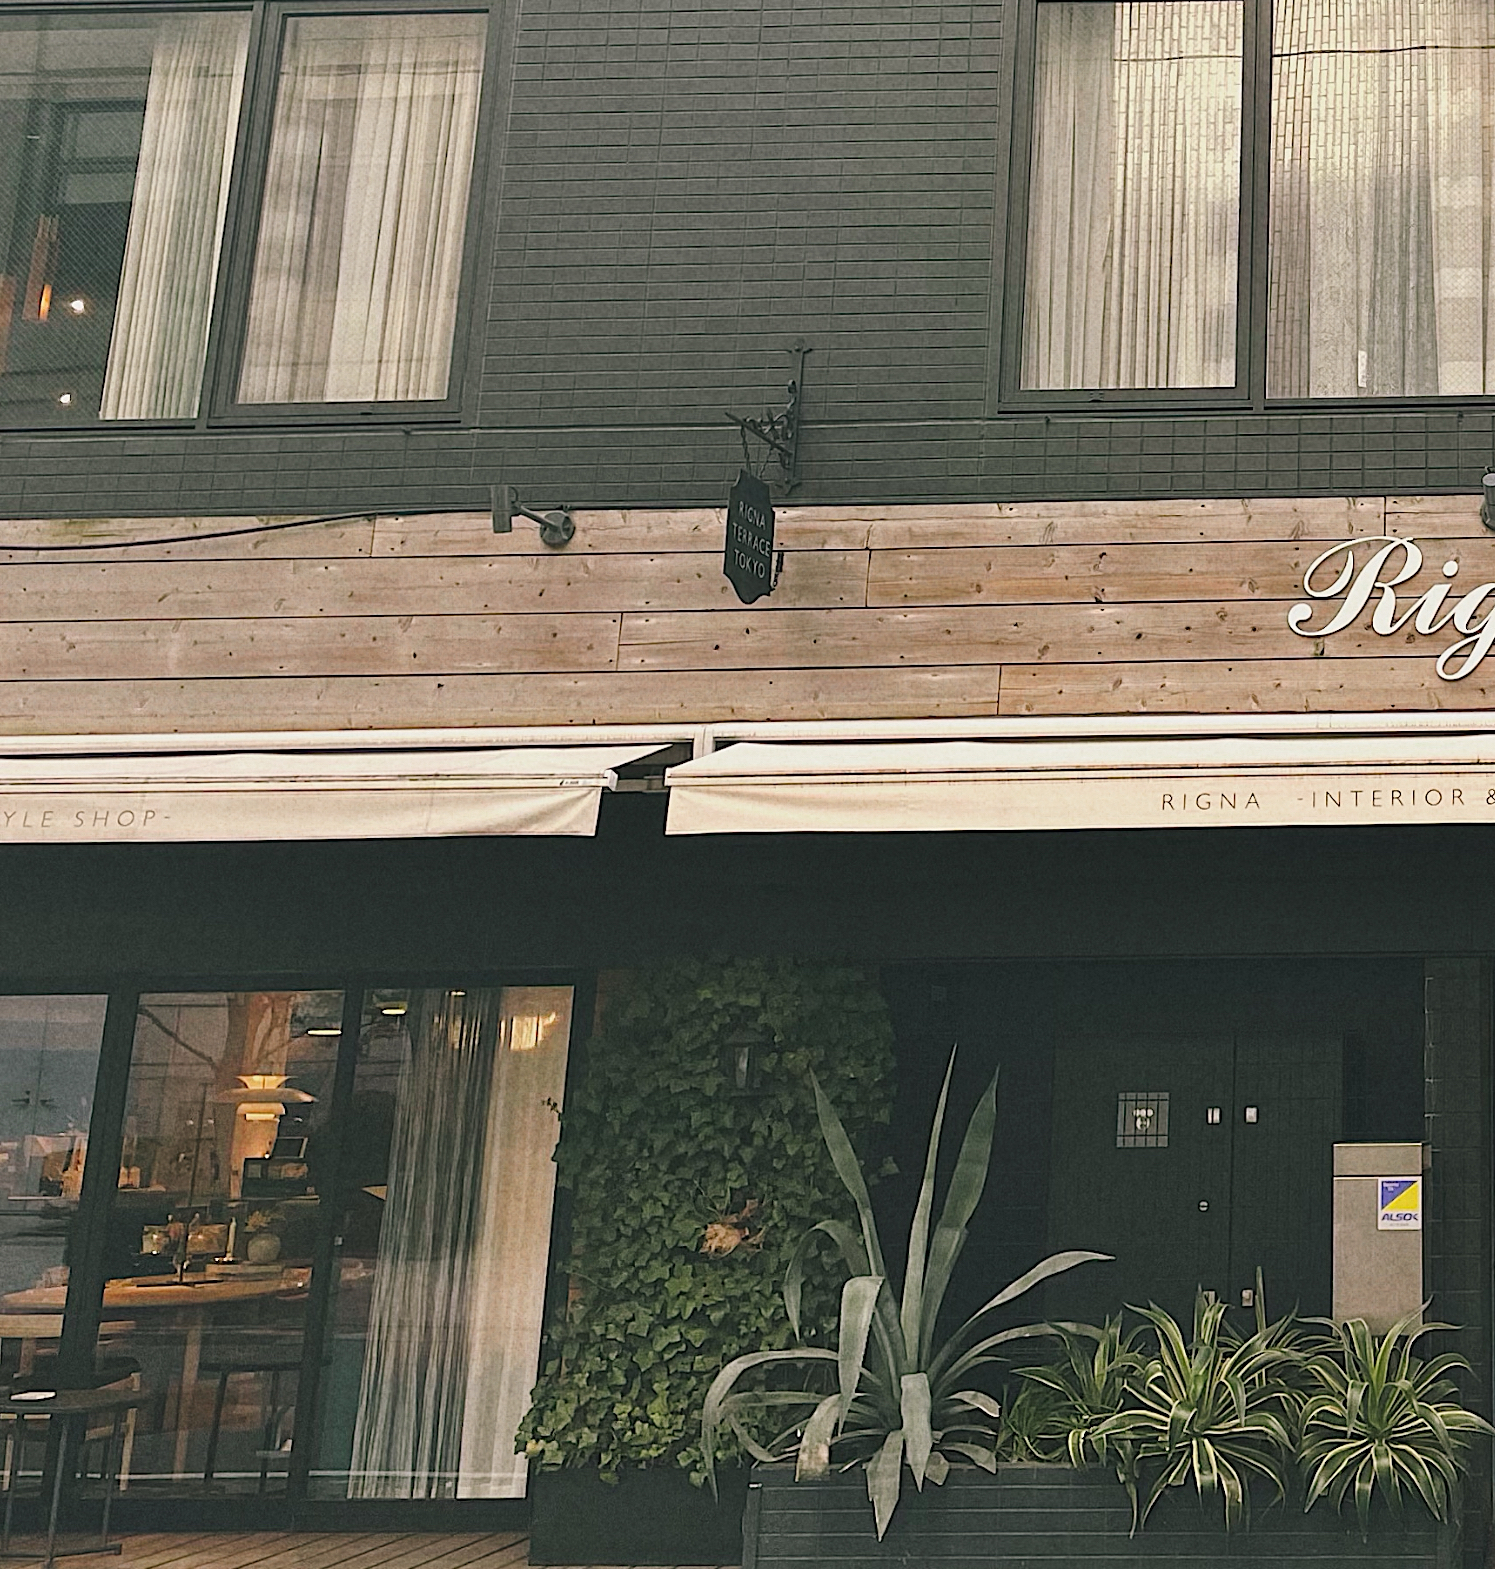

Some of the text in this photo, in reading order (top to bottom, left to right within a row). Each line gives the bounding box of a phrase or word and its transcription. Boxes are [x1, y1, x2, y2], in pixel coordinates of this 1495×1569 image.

[738, 501, 766, 530] RIGNA
[732, 522, 771, 557] TERRACE
[734, 549, 765, 578] TOKYO
[1161, 792, 1261, 811] RIGNA
[1297, 788, 1465, 809] -INTERIOR
[73, 810, 171, 828] SHOP-
[1381, 1212, 1419, 1221] ALSOK
